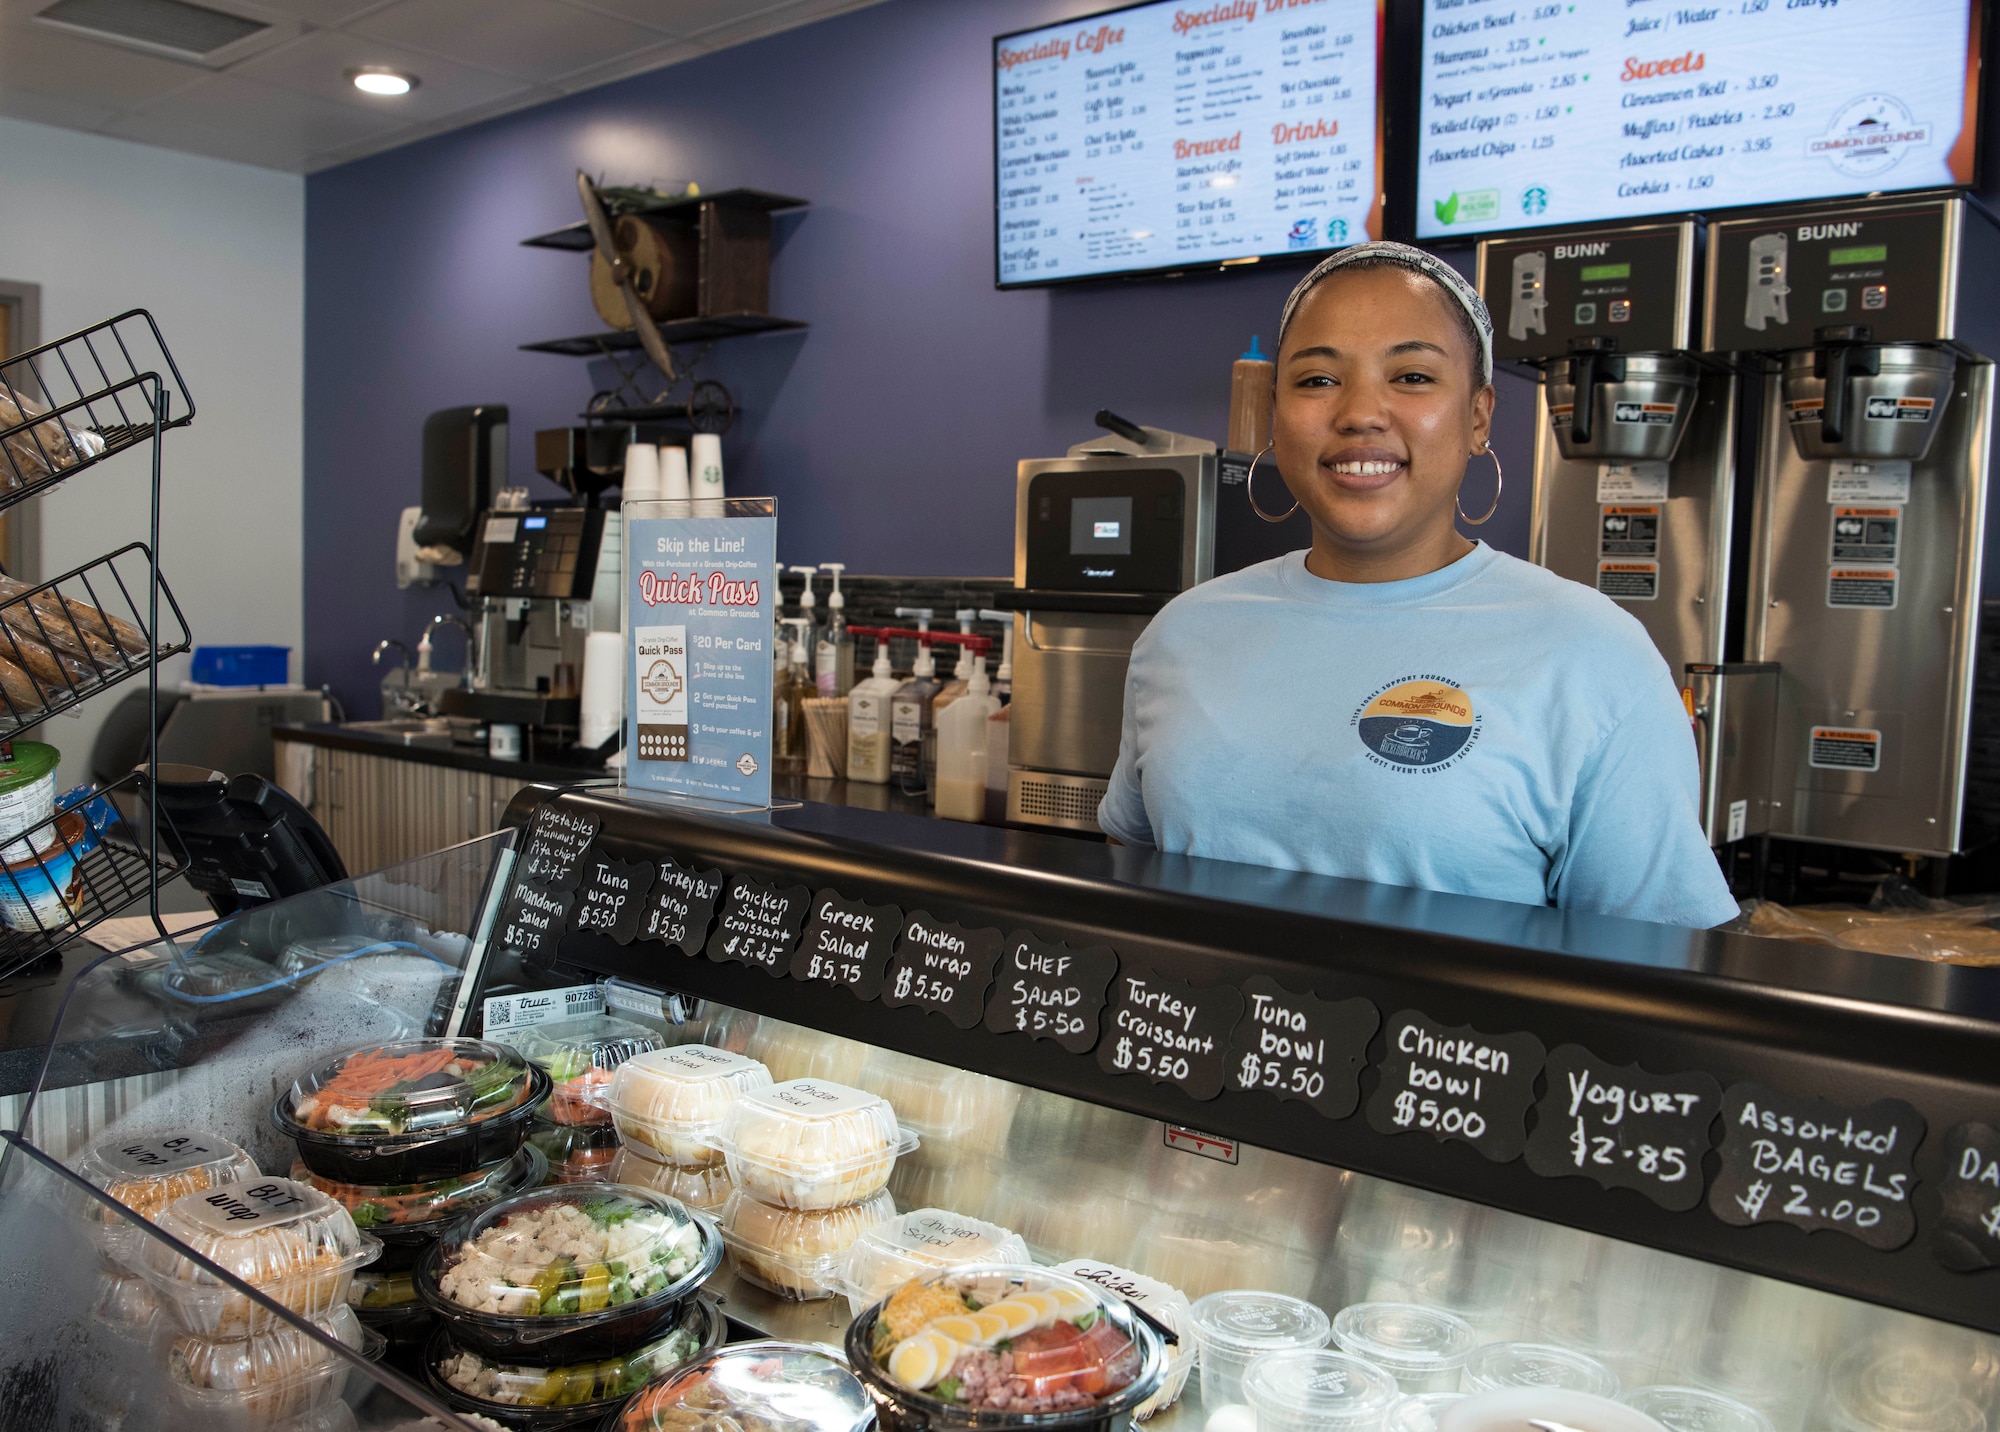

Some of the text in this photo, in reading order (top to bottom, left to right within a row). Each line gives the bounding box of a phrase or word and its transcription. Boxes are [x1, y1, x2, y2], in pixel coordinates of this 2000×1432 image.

[1172, 0, 1257, 36] Specialty
[1432, 20, 1480, 39] Chicken
[1484, 11, 1516, 28] Bowl
[1625, 17, 1661, 37] Juice
[1675, 7, 1720, 26] Water
[997, 38, 1070, 73] Specialty
[1075, 25, 1125, 54] Coffee
[1433, 47, 1489, 66] Hummus
[1621, 50, 1705, 82] Sweets
[1430, 90, 1472, 109] Yogurt
[1621, 89, 1693, 108] Cinnamon
[1697, 80, 1727, 97] Roll
[1271, 118, 1338, 145] Drinks
[1470, 115, 1500, 132] Eggs
[1622, 103, 1795, 140] Muffins Pastries 2.50
[1173, 130, 1242, 160] Brewed
[1428, 147, 1479, 166] Assorted
[1482, 142, 1515, 157] Chips
[1810, 129, 1925, 152] COMMON GROUNDS
[1293, 149, 1320, 163] Drinks
[1619, 150, 1679, 169] Assorted
[1681, 141, 1723, 160] Cakes
[1297, 184, 1325, 197] Drinks
[1618, 180, 1669, 198] Cookies
[1797, 222, 1858, 241] BUNN
[1554, 243, 1606, 259] BUNN
[657, 537, 745, 556] Skip the Line!
[639, 570, 760, 607] Quick Pass
[698, 607, 727, 617] Common
[730, 608, 760, 618] Grounds
[639, 645, 683, 656] Quick Pass
[693, 635, 761, 651] $20 Per Card
[694, 662, 700, 672] 1
[732, 663, 742, 671] the
[735, 672, 745, 680] line
[1381, 675, 1416, 691] SUPPORT
[1420, 674, 1462, 689] SQUADRON
[694, 692, 700, 703] 2
[702, 692, 712, 701] Get
[726, 694, 741, 703] Quick
[742, 695, 756, 703] Pass
[702, 701, 715, 709] card
[1379, 700, 1467, 717] COMMON GROUNDS
[693, 724, 699, 734] 3
[702, 725, 715, 733] Grab
[729, 727, 746, 736] coffee
[1365, 741, 1475, 775] SCOTT EVENT CENTER SCOTT
[535, 826, 575, 846] Hummus
[539, 809, 594, 836] Vegetables
[530, 840, 576, 866] Pita chips
[596, 863, 629, 891] Tuna
[660, 863, 718, 900] Turkey BLT
[588, 888, 626, 913] wrap
[660, 893, 689, 922] wrap
[519, 908, 550, 930] Salad
[578, 905, 617, 928] $5.50
[648, 908, 686, 943] $5.50
[819, 901, 875, 934] Greek
[503, 924, 541, 949] $5.75
[817, 929, 870, 961] Salad
[907, 922, 965, 955] Chicken
[807, 954, 862, 983] $5.75
[924, 952, 972, 981] wrap
[1014, 944, 1073, 976] CHEF
[894, 966, 954, 1003] $5.50
[1011, 979, 1081, 1007] SALAD
[1126, 977, 1197, 1032] Turkey
[1251, 994, 1306, 1033] Tuna
[1112, 1036, 1189, 1080] $5.50
[1260, 1028, 1325, 1065] bowl
[1398, 1025, 1509, 1076] Chicken
[663, 1054, 703, 1070] Salad
[1237, 1052, 1325, 1098] $5.50
[1408, 1061, 1481, 1101] bowl
[1392, 1089, 1486, 1139] $5.00
[1739, 1102, 1897, 1155] Assorted
[163, 1137, 209, 1156] BLT
[1569, 1114, 1687, 1182] $2.85
[1750, 1139, 1907, 1202] BAGELS
[246, 1184, 304, 1208] BLT
